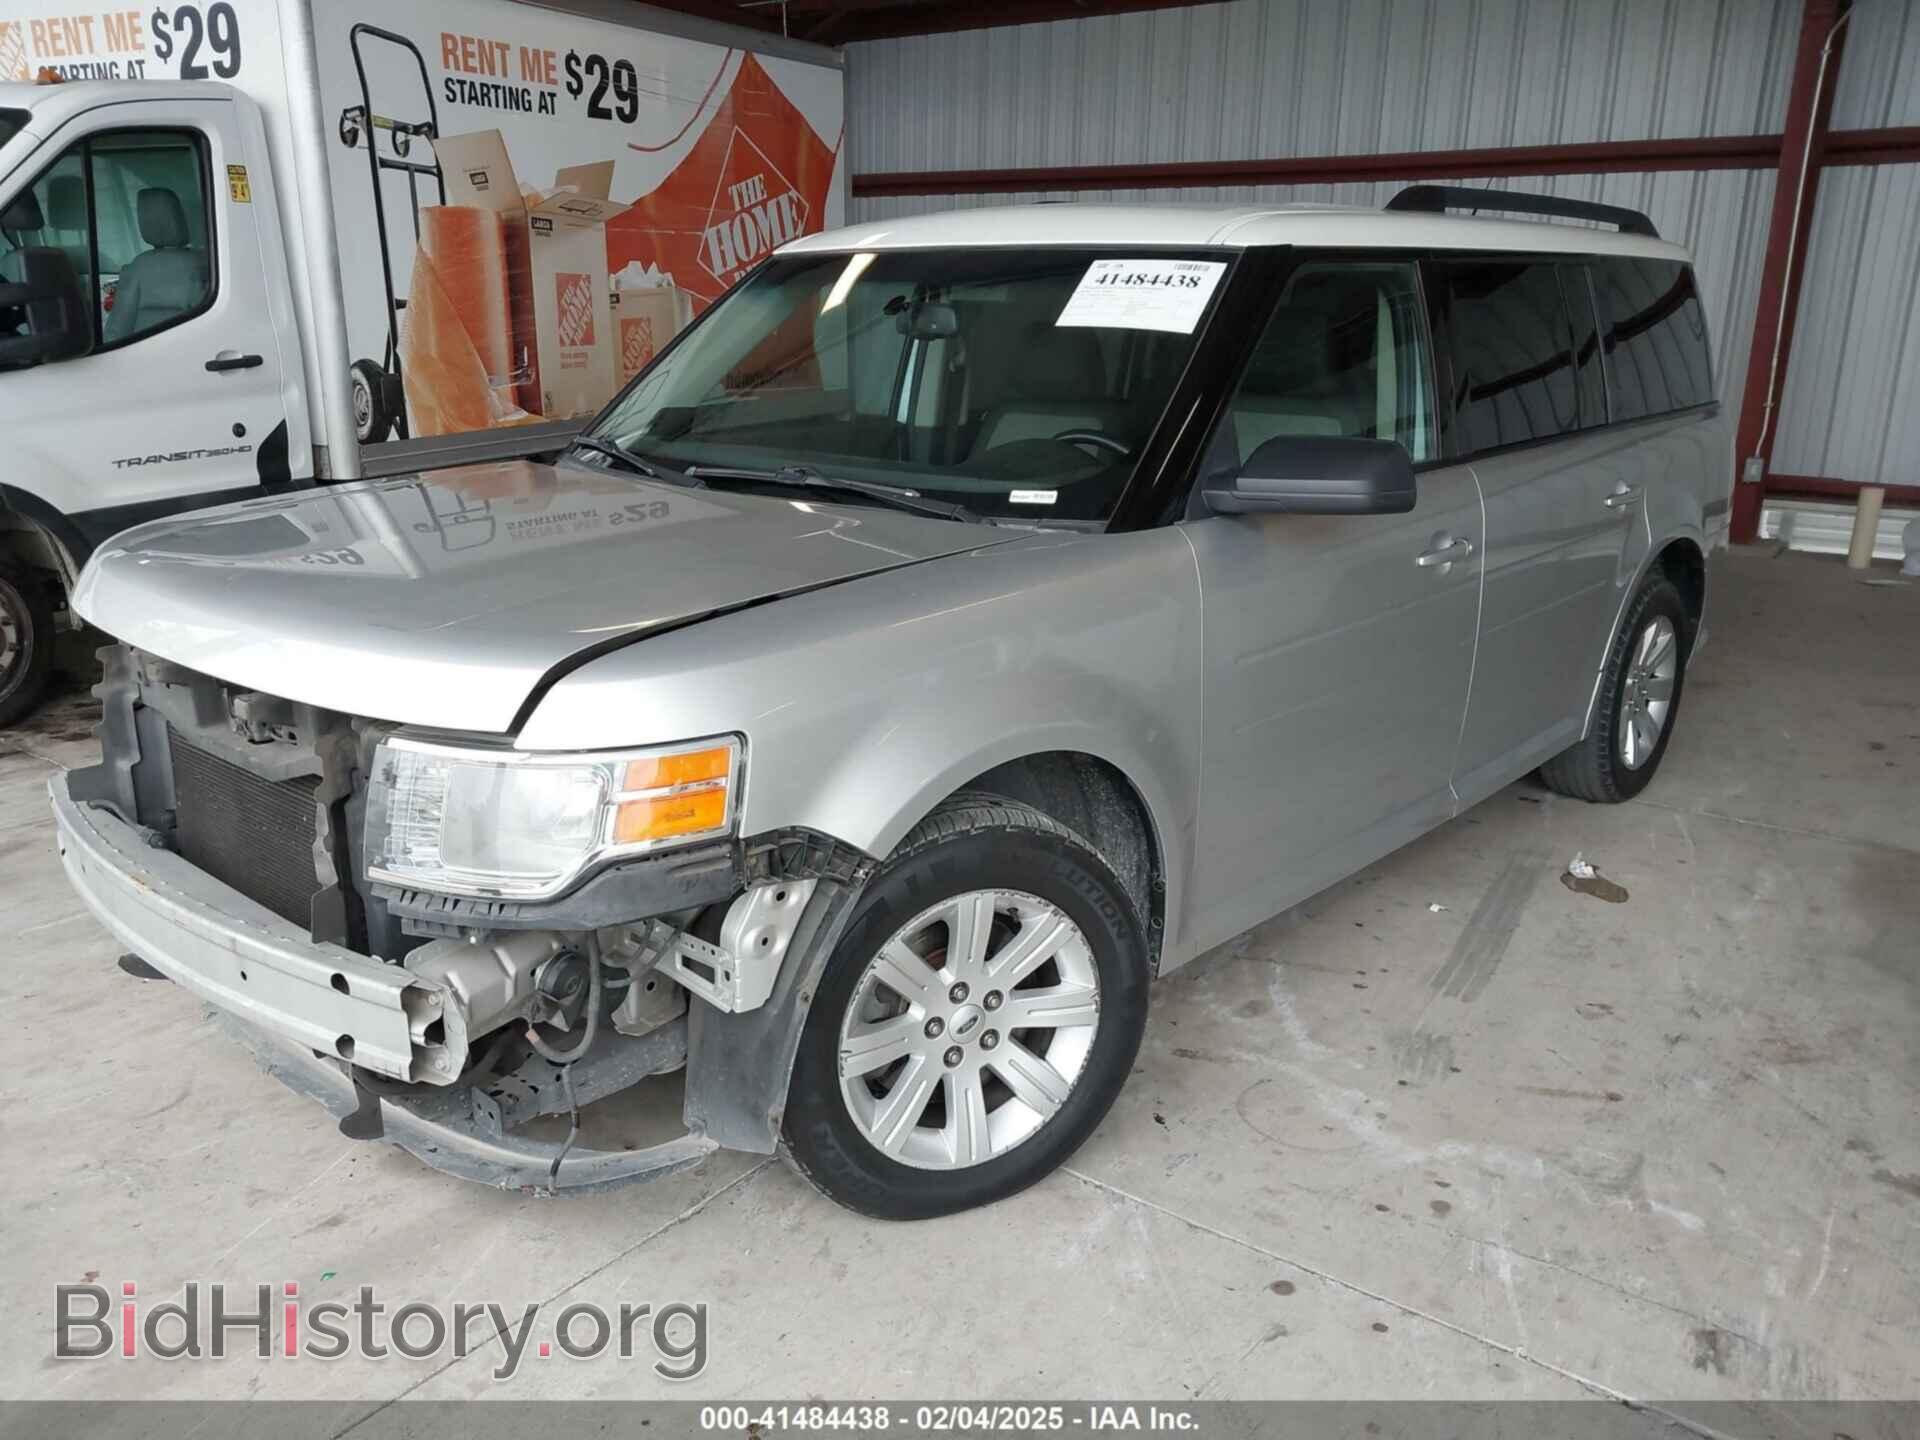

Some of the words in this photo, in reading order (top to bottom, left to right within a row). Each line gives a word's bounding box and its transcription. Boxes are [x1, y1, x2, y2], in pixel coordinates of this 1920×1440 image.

[30, 16, 94, 57] RENT
[102, 11, 144, 52] ME
[151, 2, 241, 80] $29
[440, 32, 510, 78] RENT
[520, 46, 558, 85] ME
[444, 77, 532, 112] STARTING
[538, 90, 557, 115] AT
[564, 49, 639, 124] $29
[728, 173, 768, 212] THE
[706, 190, 803, 276] HOME
[1095, 272, 1201, 289] 41484438
